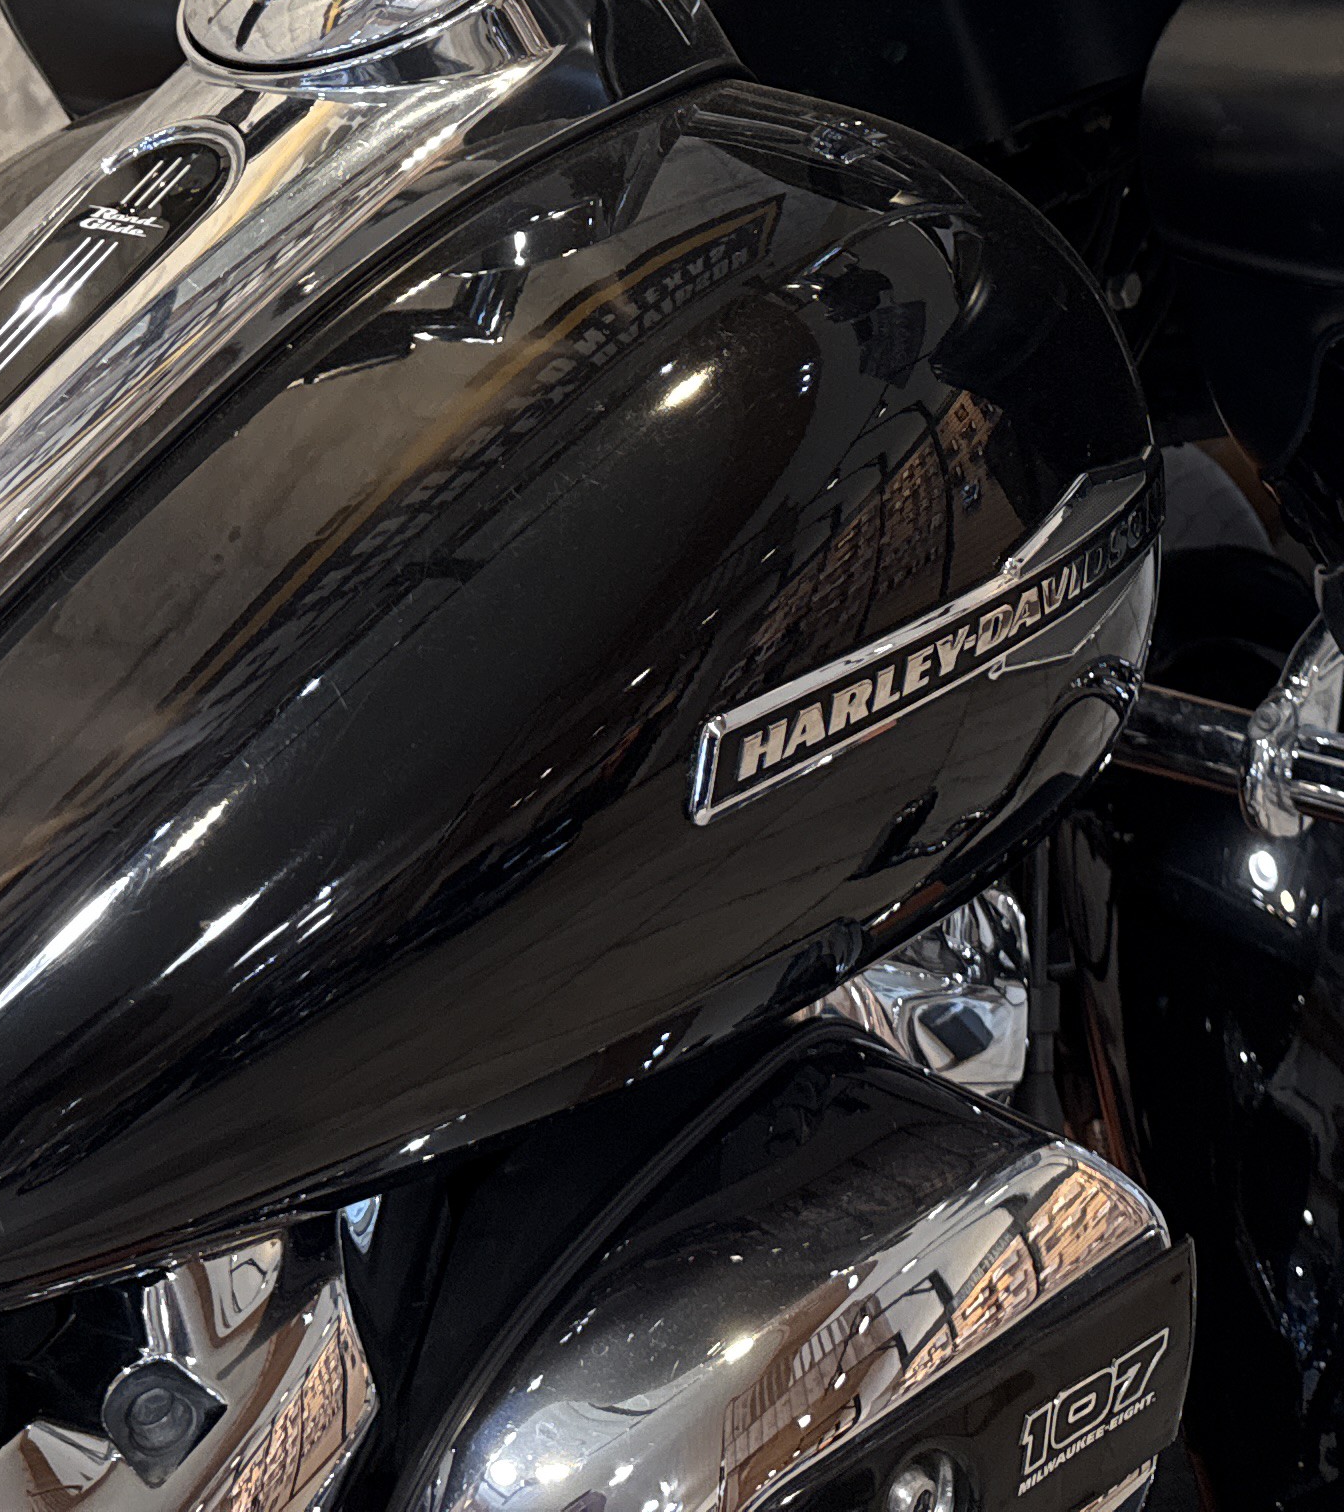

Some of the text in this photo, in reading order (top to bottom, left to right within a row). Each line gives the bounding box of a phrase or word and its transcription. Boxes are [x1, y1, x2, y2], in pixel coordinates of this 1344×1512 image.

[79, 217, 147, 238] Glide
[89, 204, 164, 228] Road
[737, 475, 1164, 782] HARLEY-DAVIDSON
[1019, 1326, 1170, 1476] 107
